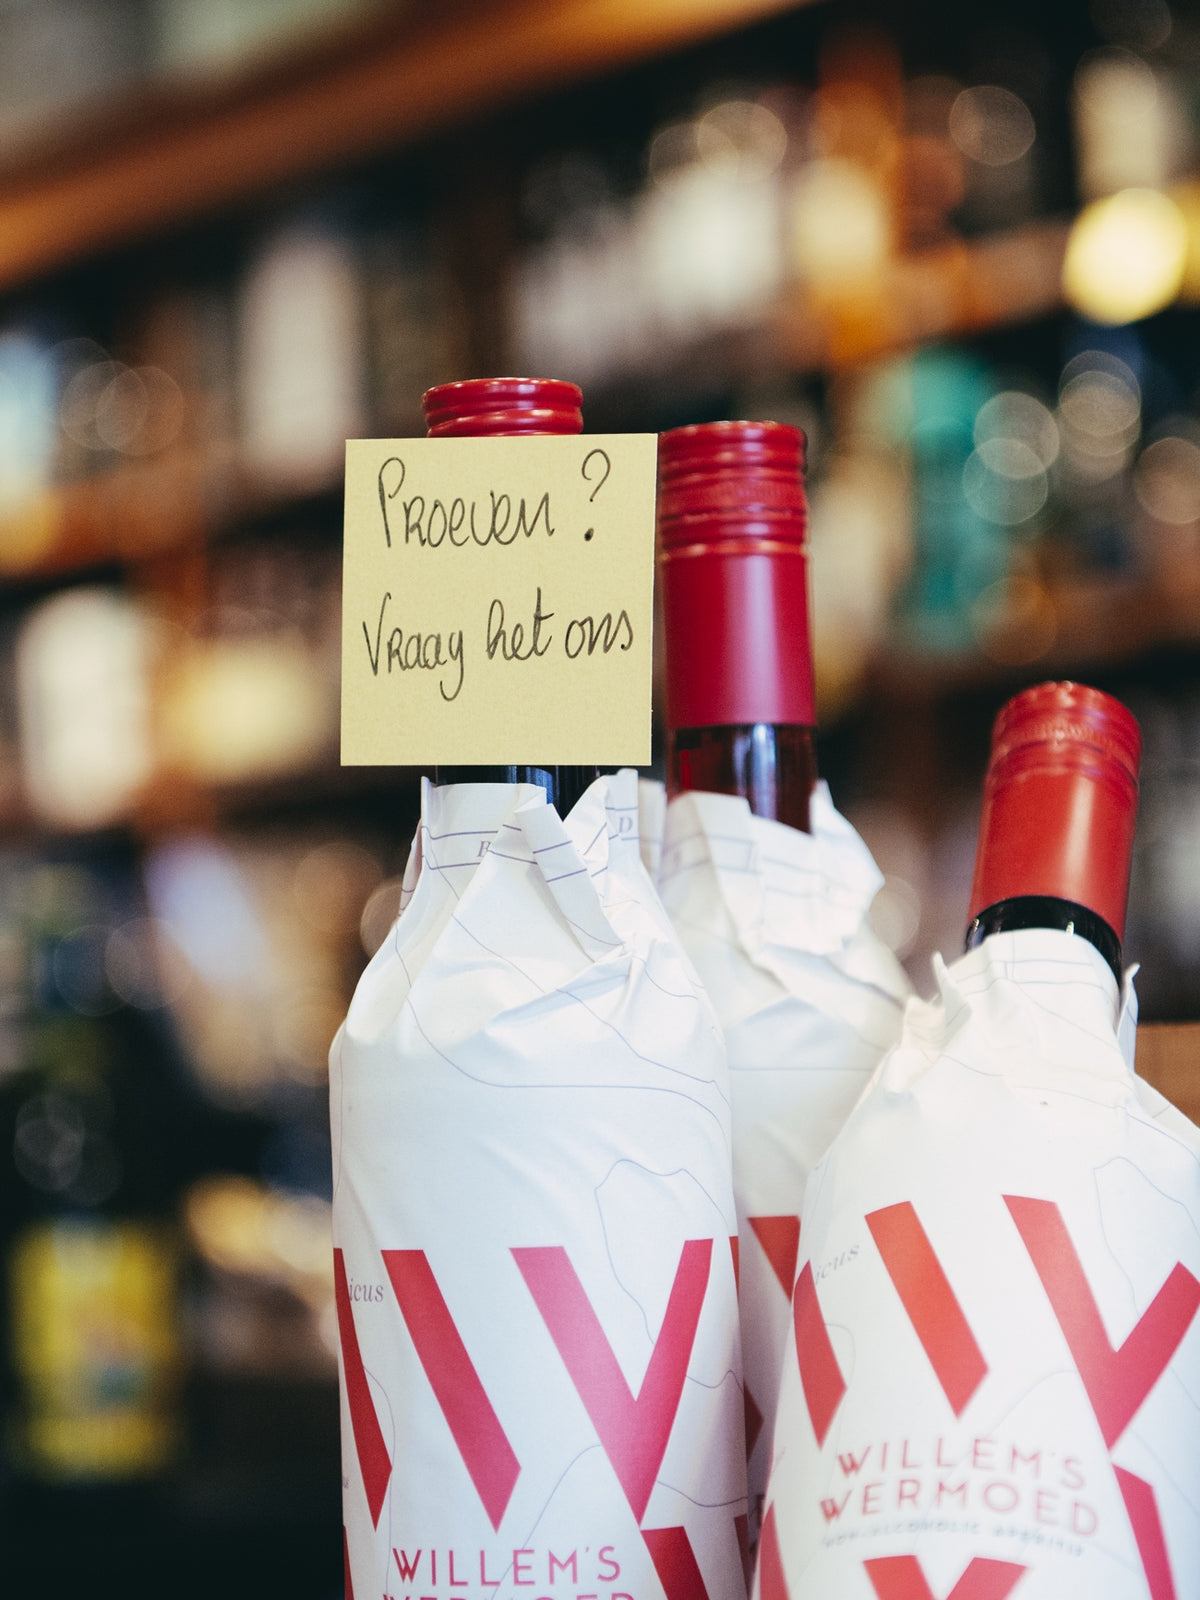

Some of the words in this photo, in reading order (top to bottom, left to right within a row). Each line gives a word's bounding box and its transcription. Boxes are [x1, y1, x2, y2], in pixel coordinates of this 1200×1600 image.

[485, 586, 555, 662] het
[564, 609, 634, 660] ons
[837, 1437, 1087, 1491] WILLEM'S
[392, 1545, 622, 1587] WILLEM'S
